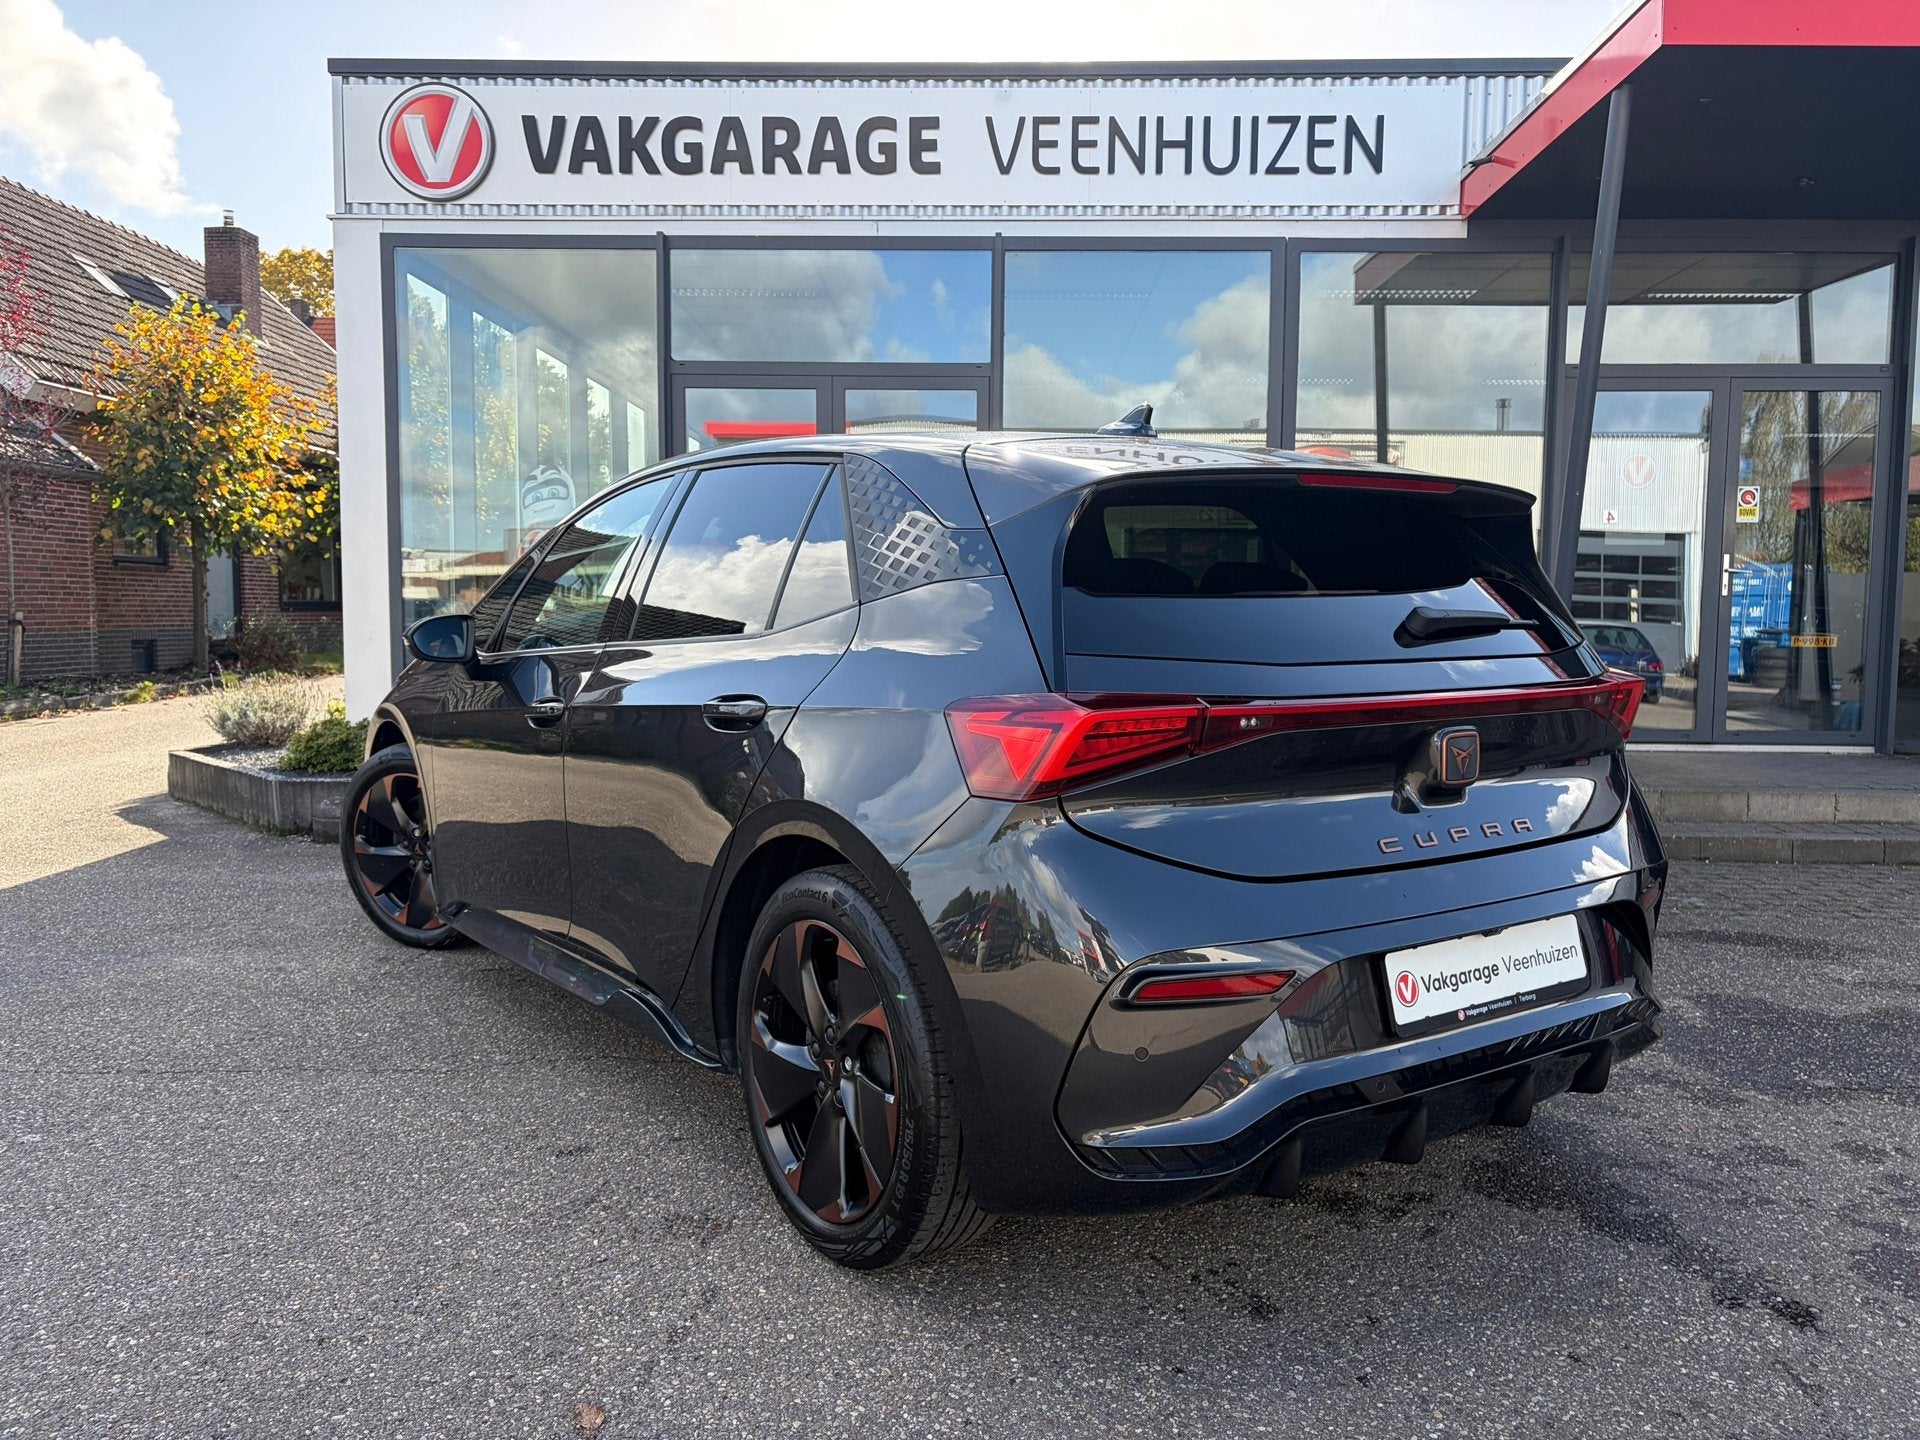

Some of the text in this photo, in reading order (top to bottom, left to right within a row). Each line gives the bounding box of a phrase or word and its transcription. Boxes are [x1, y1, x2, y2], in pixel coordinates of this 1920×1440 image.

[521, 114, 941, 175] VAKGARAGE
[985, 114, 1385, 175] VEENHUIZEN
[1377, 818, 1534, 854] CUPRA
[781, 887, 822, 904] EcoContact
[1420, 962, 1500, 993] Vakgarage
[1501, 944, 1579, 974] Veenhuizen
[1465, 1005, 1489, 1016] Vakgarage
[1488, 998, 1513, 1011] Veenhuizen
[901, 1117, 915, 1170] 215/50
